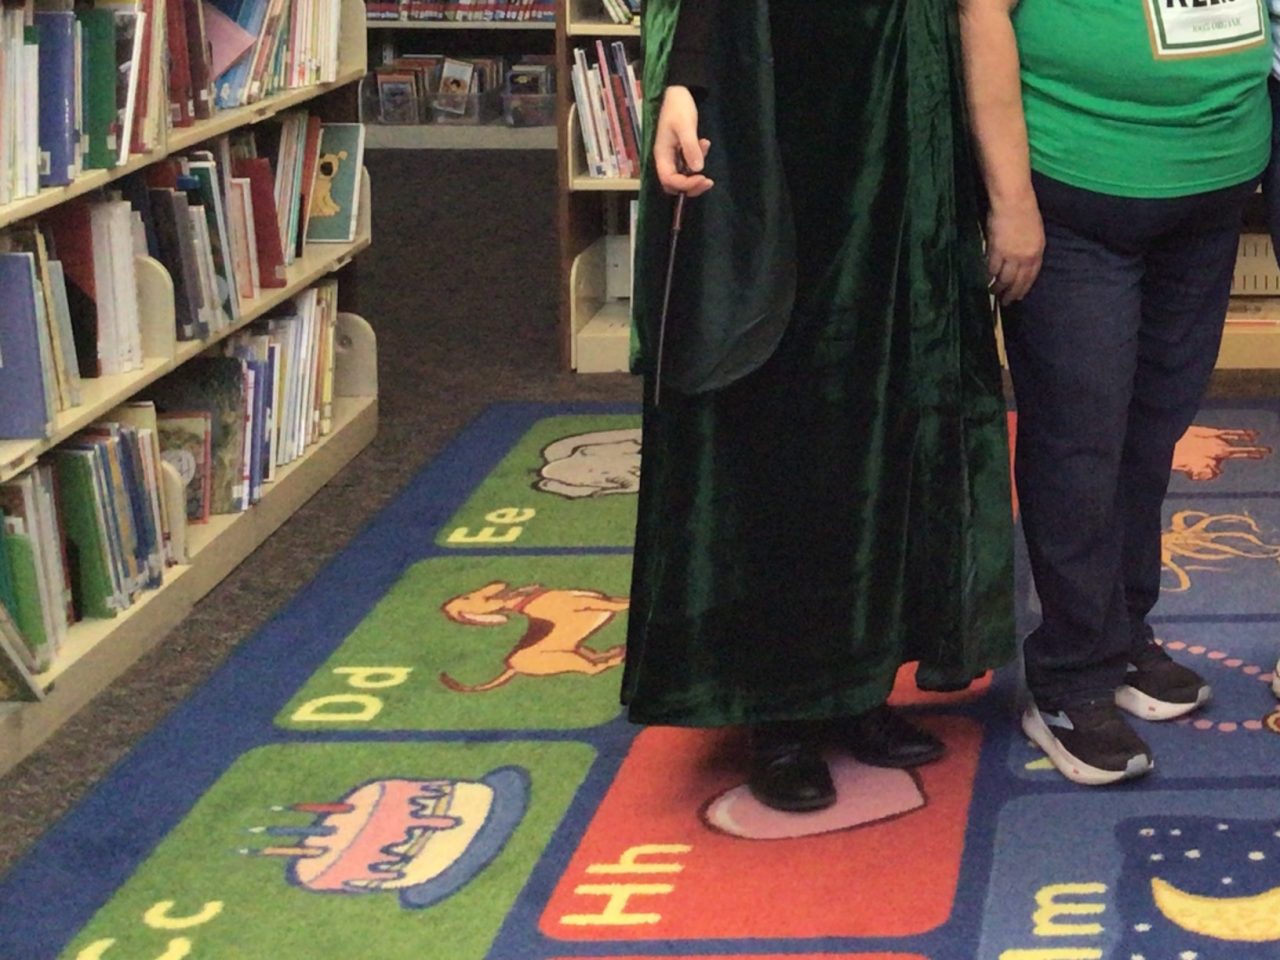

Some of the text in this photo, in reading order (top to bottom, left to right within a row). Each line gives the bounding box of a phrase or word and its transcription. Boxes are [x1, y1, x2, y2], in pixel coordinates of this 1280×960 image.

[447, 506, 536, 544] Ee
[291, 665, 414, 723] Dd
[560, 843, 692, 926] Hh
